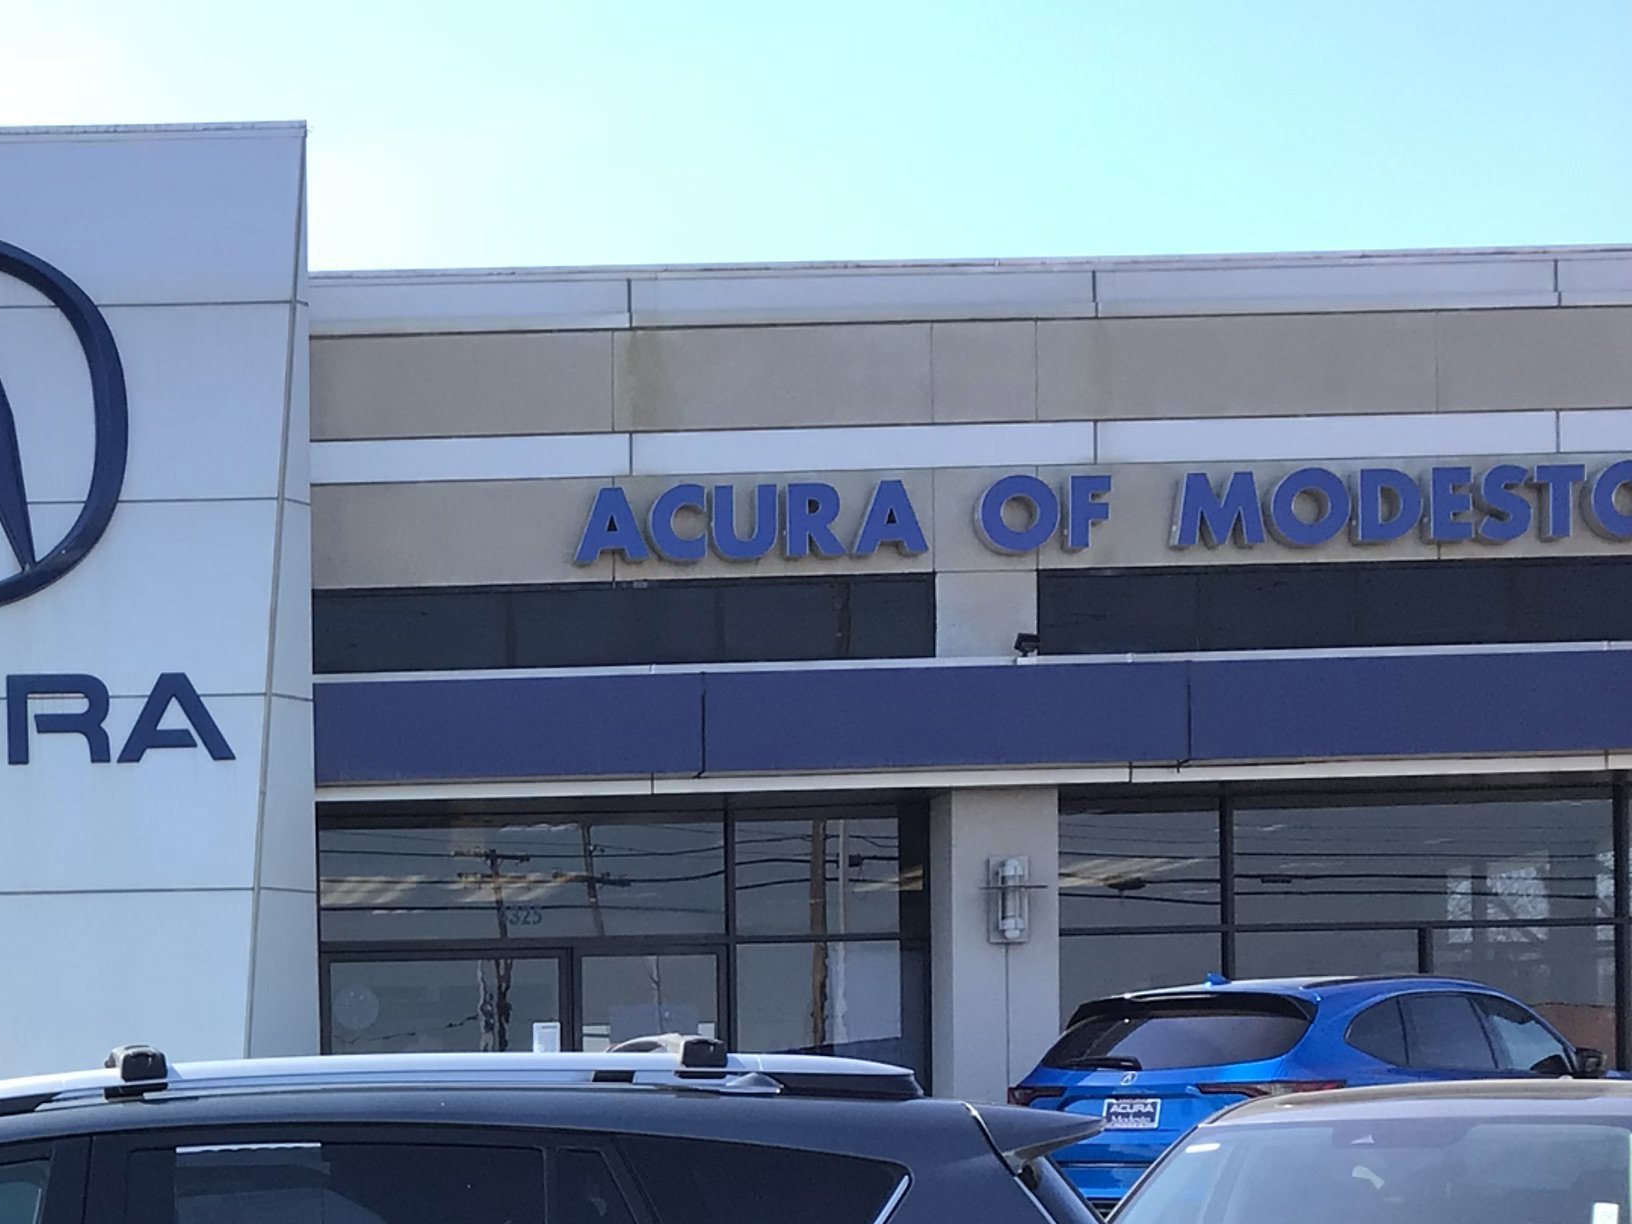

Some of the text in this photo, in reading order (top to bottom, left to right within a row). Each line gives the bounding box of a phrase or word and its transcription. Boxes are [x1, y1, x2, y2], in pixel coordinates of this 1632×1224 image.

[573, 479, 930, 563] ACURA
[978, 473, 1113, 552] OF
[1109, 1103, 1155, 1113] ACURA
